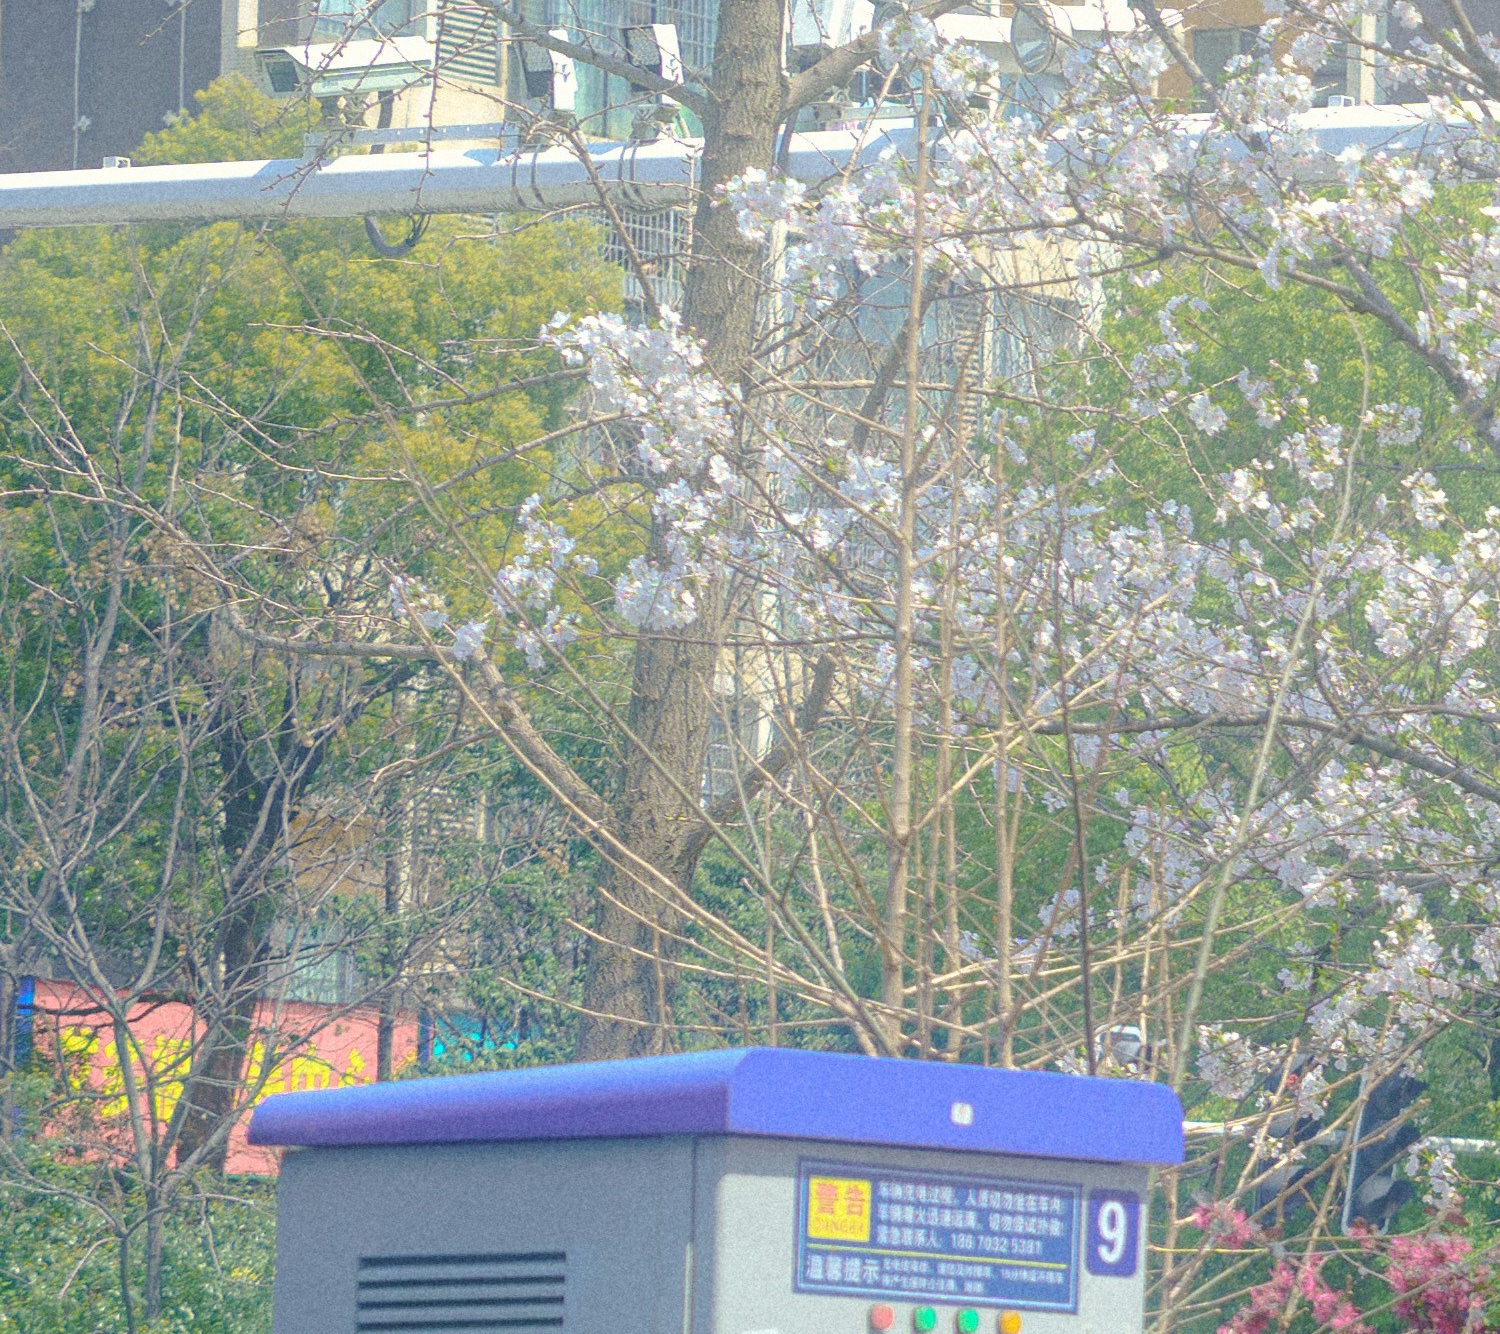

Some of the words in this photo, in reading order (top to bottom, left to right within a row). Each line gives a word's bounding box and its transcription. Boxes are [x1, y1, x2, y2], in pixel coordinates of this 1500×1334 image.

[815, 1182, 866, 1217] 警告
[1098, 1200, 1127, 1264] 9
[806, 1254, 880, 1285] 温馨提示
